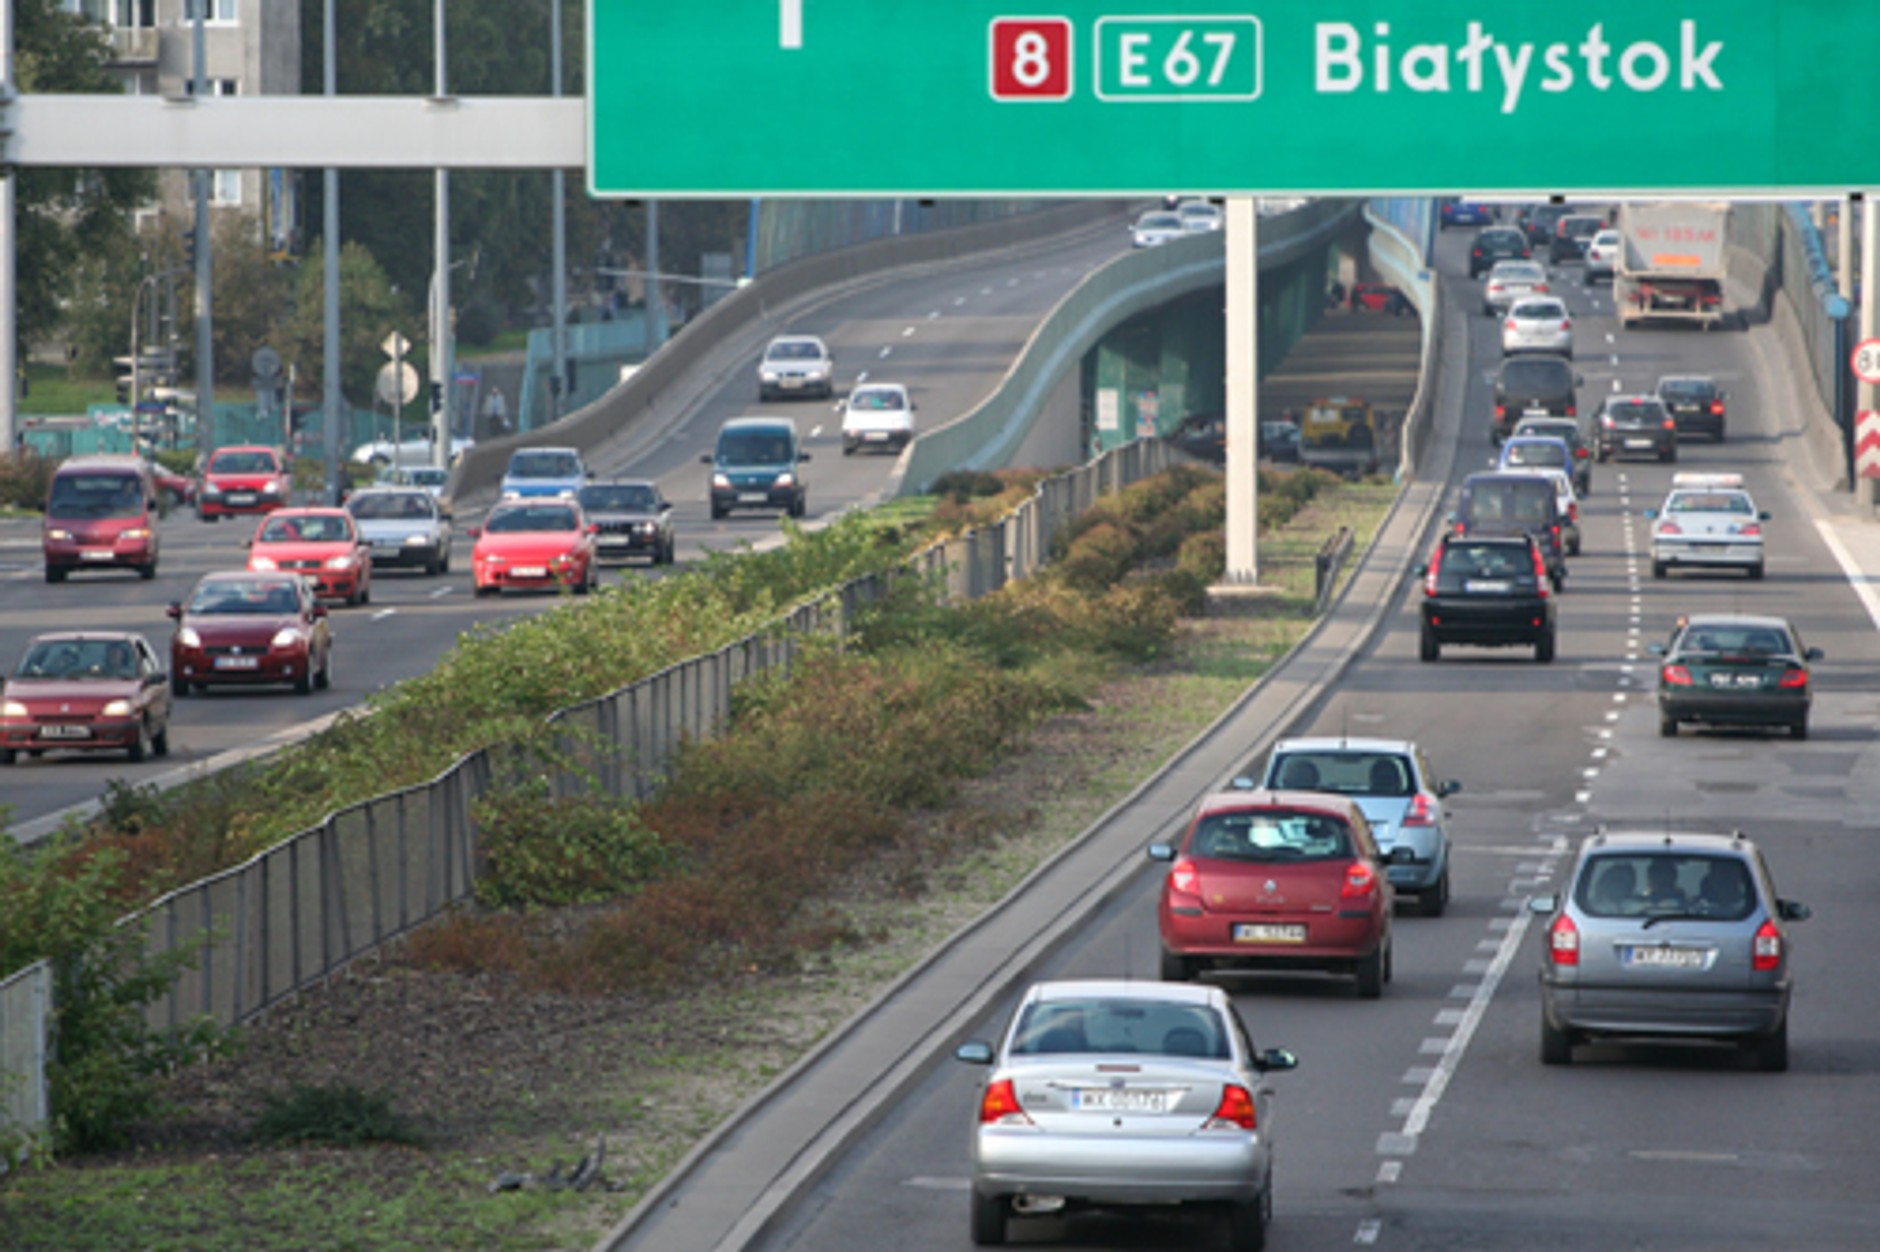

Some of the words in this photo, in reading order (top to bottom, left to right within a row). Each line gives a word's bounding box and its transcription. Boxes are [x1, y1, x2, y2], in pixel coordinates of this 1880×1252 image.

[1012, 31, 1050, 87] 8
[1120, 33, 1150, 86] E
[1164, 31, 1236, 86] 67
[1315, 20, 1723, 113] Białystok
